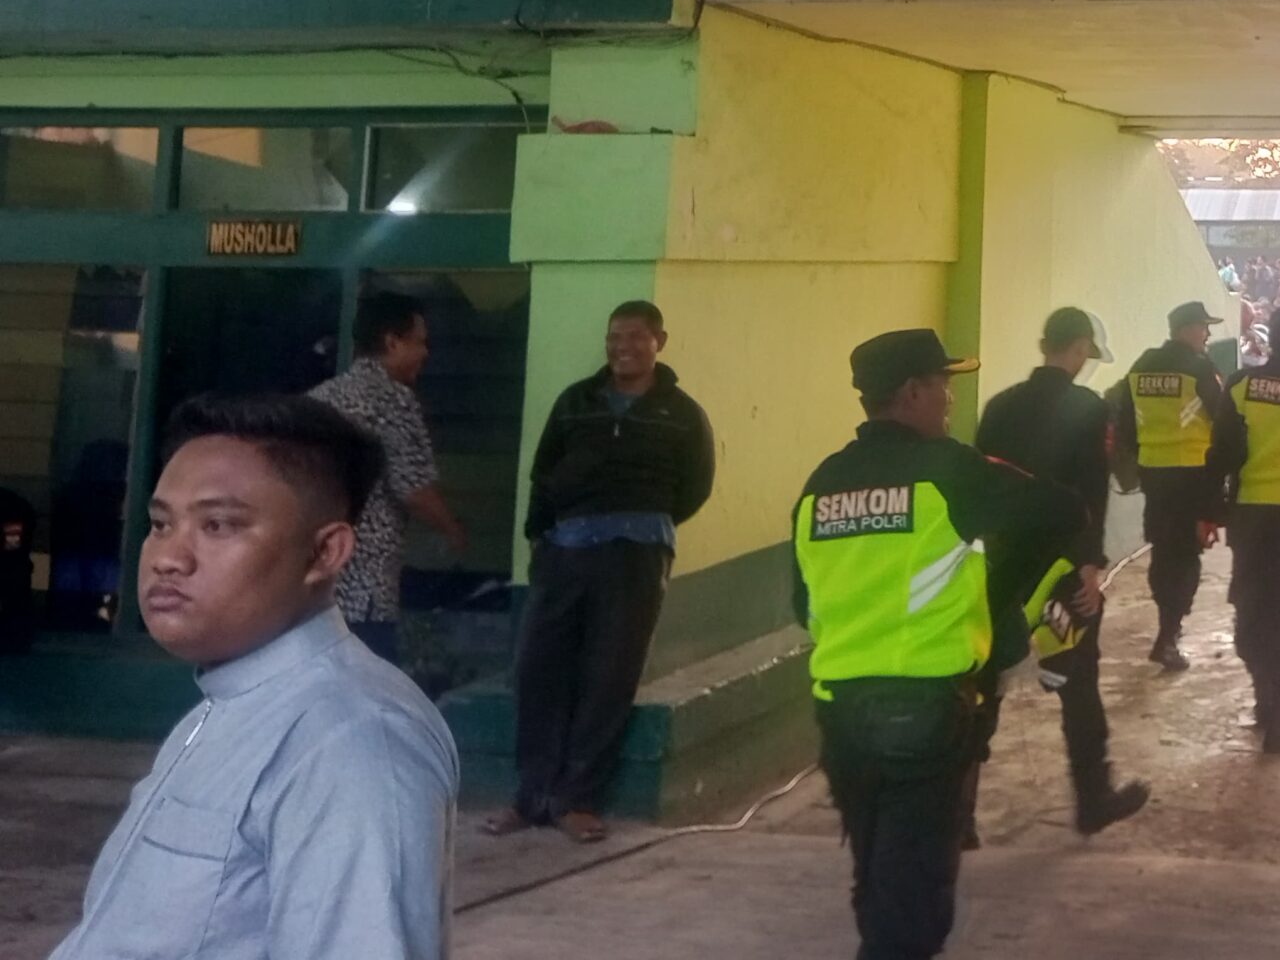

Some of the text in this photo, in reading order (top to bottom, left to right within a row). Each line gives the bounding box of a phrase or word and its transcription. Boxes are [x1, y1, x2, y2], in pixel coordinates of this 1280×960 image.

[210, 222, 297, 254] MUSHOLLA
[815, 486, 909, 523] SENKOM
[815, 514, 907, 537] MITRA POLRI
